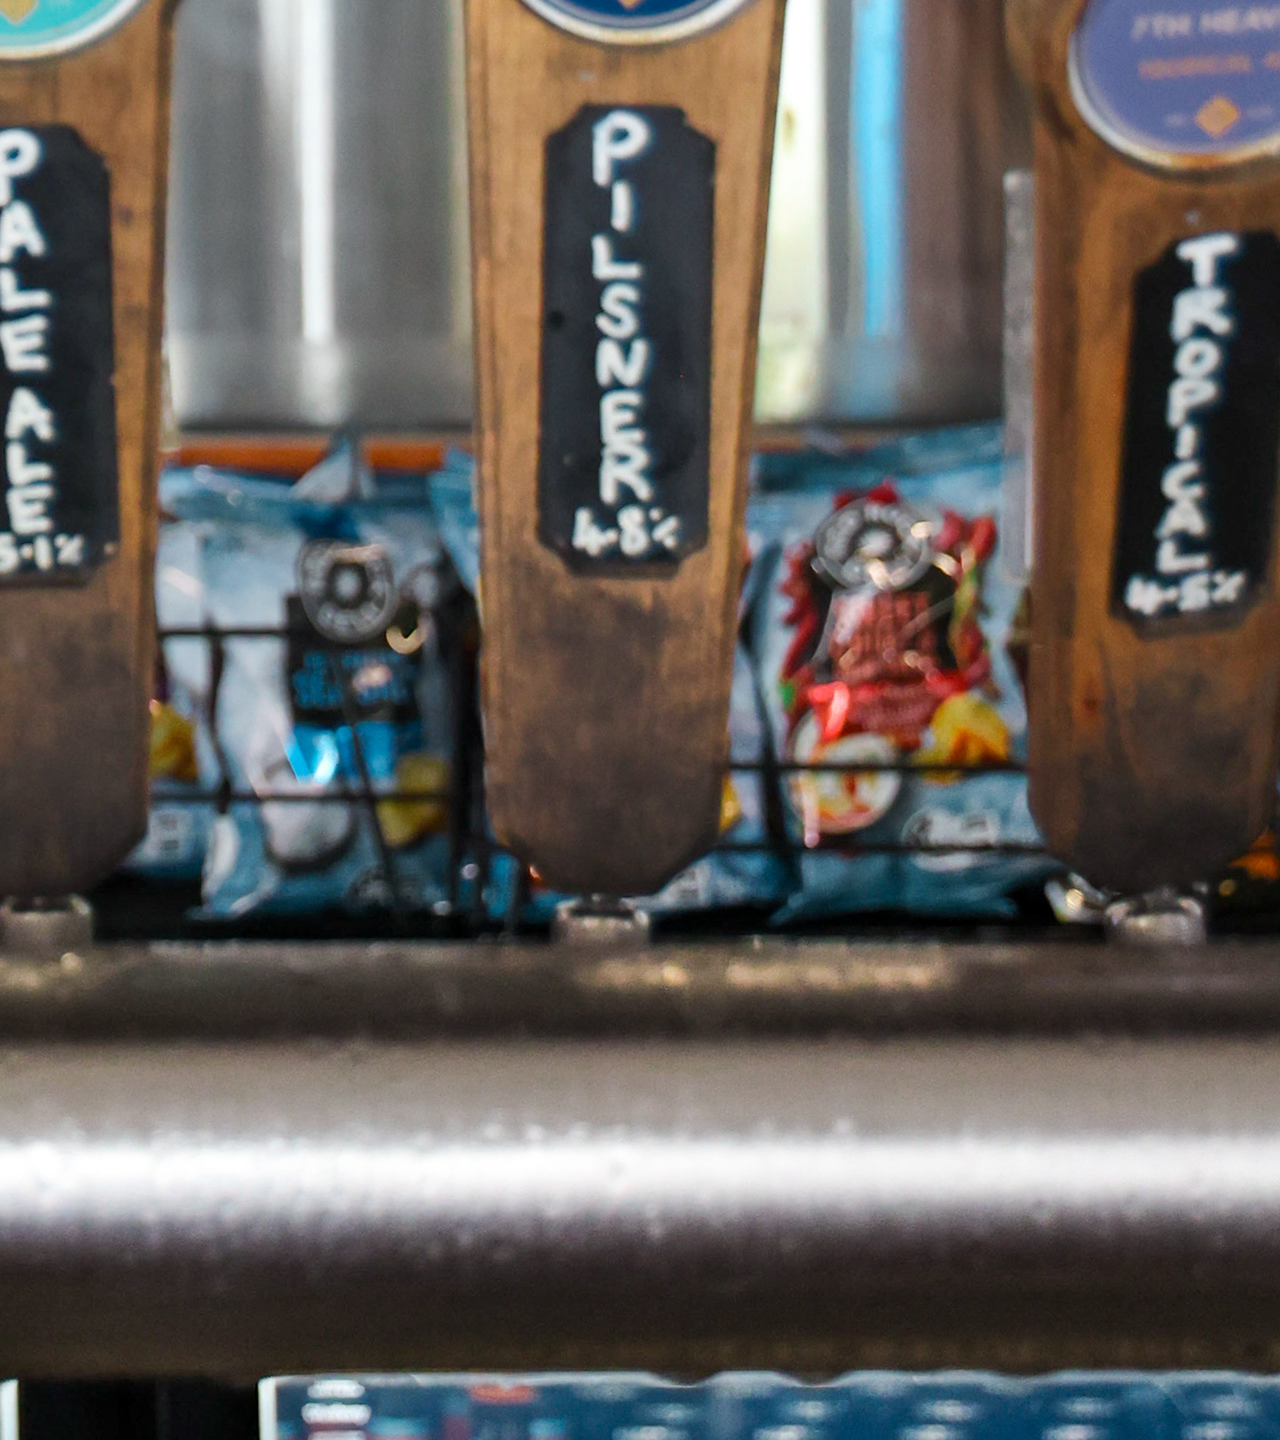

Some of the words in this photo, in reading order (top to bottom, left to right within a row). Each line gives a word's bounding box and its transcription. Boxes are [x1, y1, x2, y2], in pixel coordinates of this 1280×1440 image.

[3, 384, 55, 536] ALE
[591, 109, 653, 506] PILSNER
[1155, 231, 1239, 575] TROPICAL
